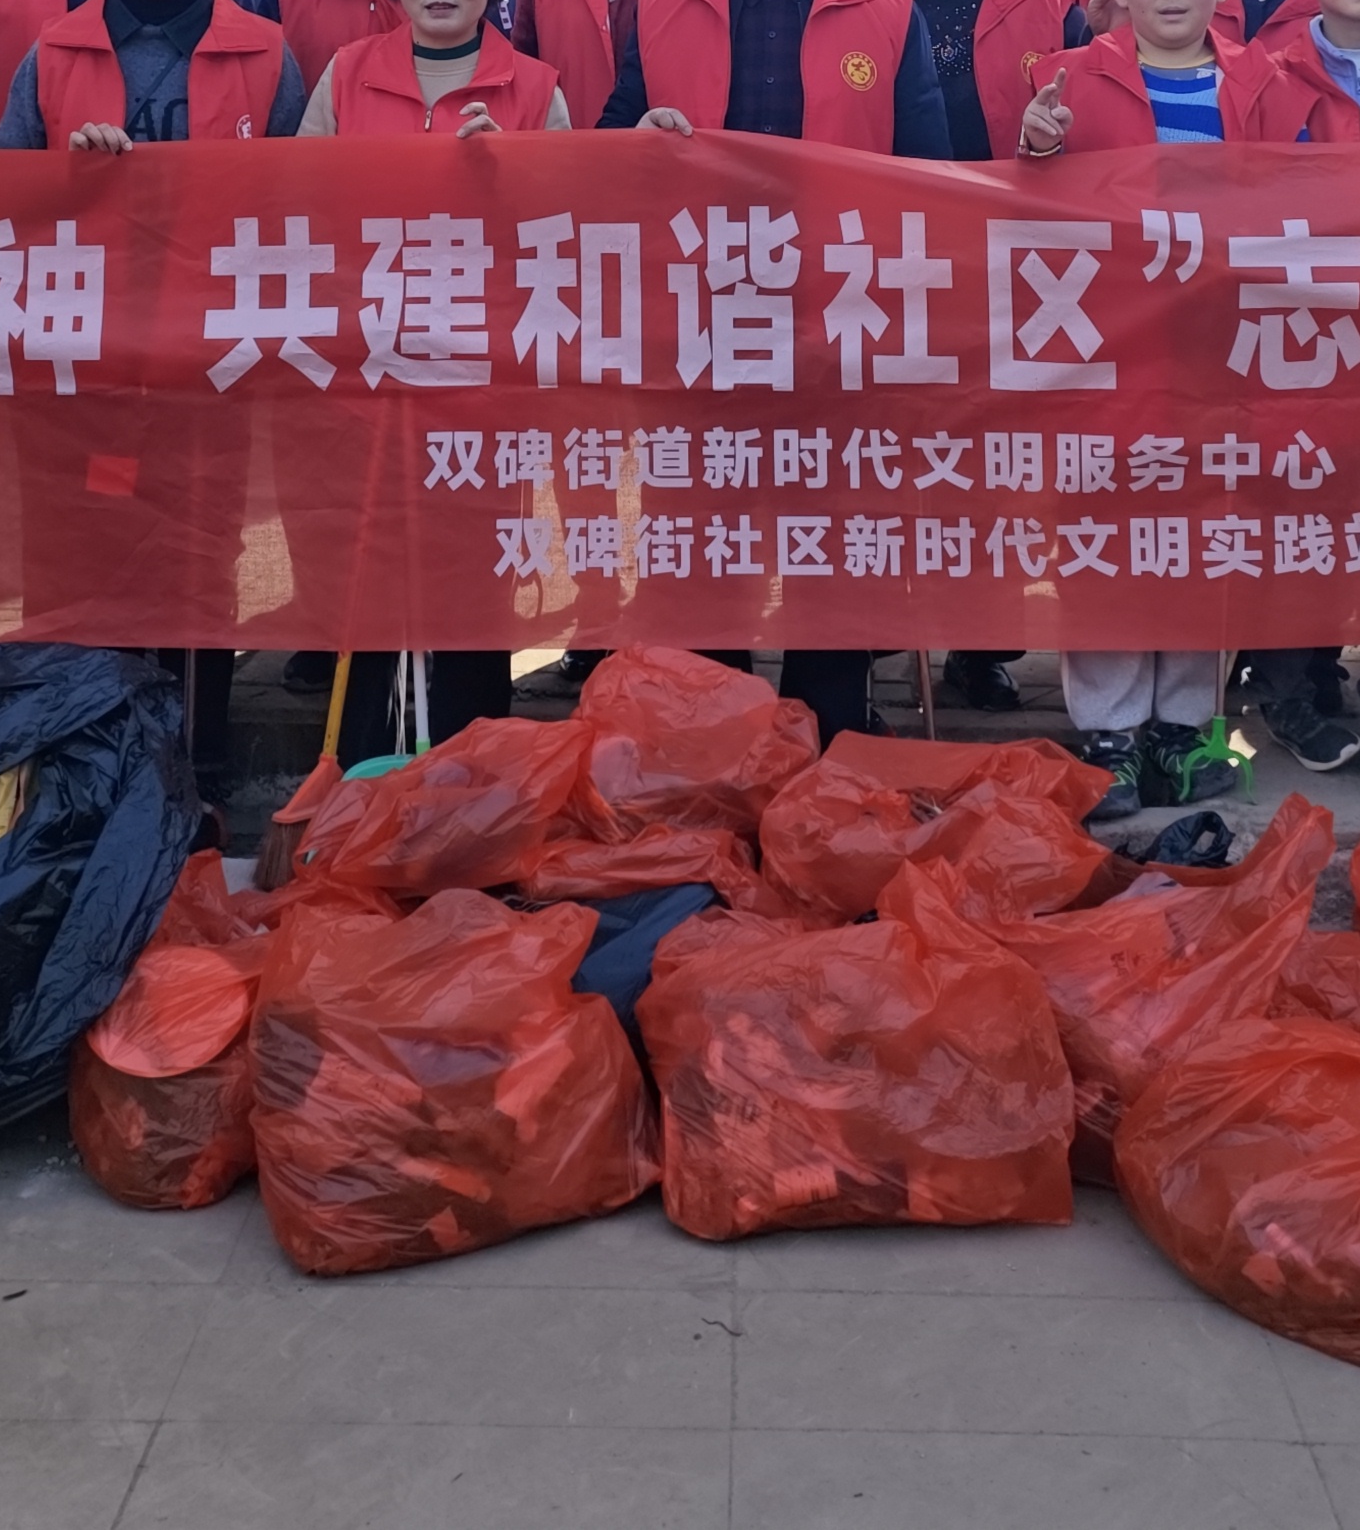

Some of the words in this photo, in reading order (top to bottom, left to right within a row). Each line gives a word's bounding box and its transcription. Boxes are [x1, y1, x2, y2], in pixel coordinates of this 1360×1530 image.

[423, 425, 1336, 493] 双碑街道新时代文明服务中心
